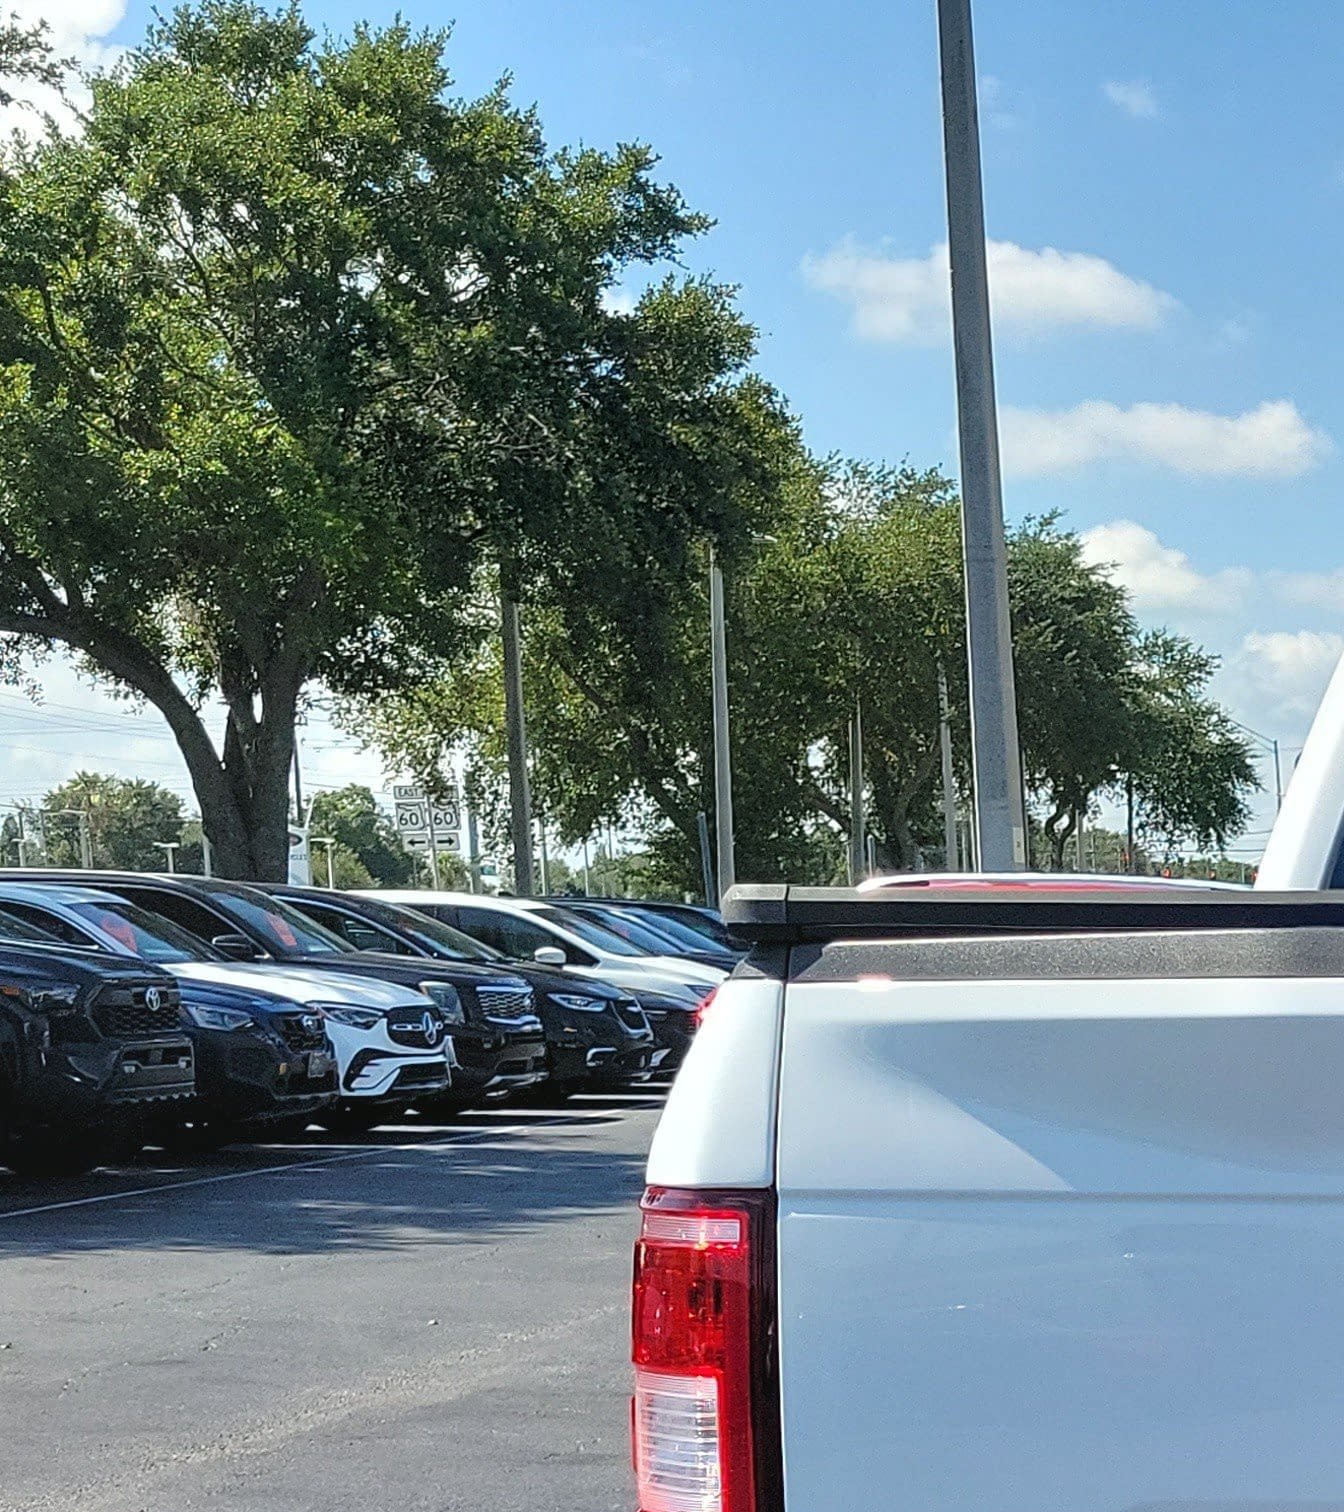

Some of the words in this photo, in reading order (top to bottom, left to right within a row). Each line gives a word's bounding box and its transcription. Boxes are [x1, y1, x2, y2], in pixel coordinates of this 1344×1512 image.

[398, 788, 419, 797] EAST
[399, 812, 419, 826] 60
[433, 811, 453, 825] 60
